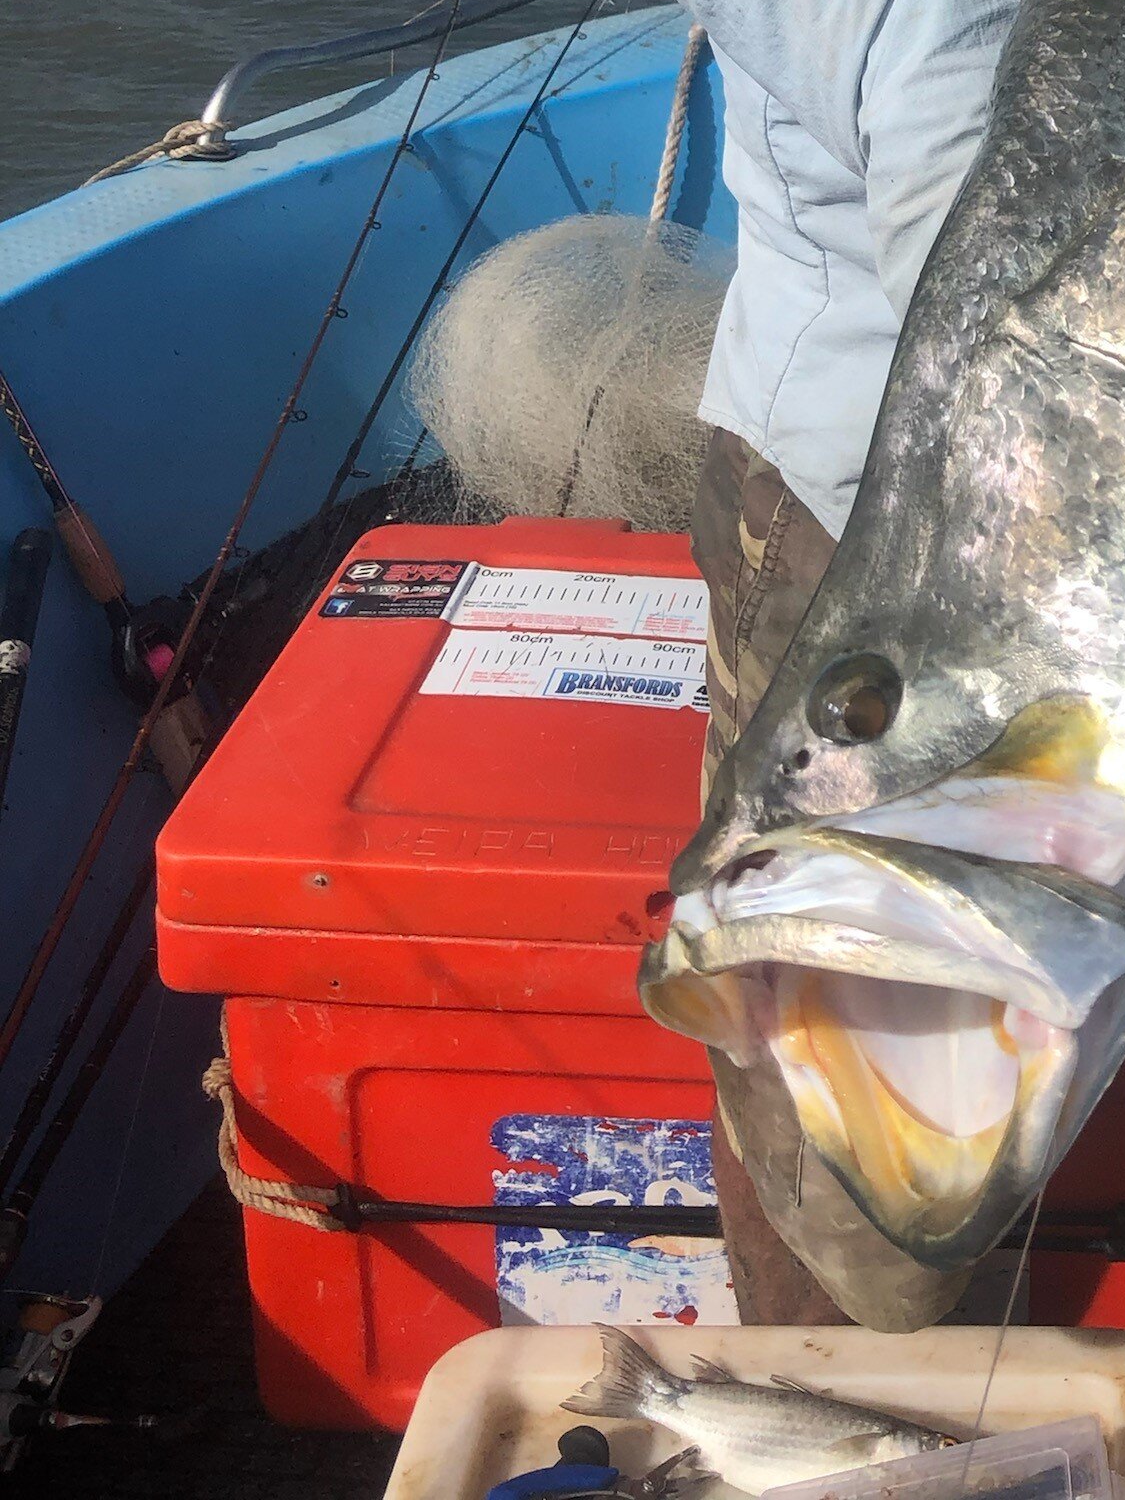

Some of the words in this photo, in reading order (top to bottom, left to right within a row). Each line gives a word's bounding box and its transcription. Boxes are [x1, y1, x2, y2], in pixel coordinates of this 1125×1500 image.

[481, 568, 514, 578] 0cm
[573, 574, 617, 584] 20cm
[380, 584, 451, 594] WRAPPING
[510, 634, 554, 644] 80cm
[652, 643, 696, 655] 90cm
[555, 671, 684, 698] BRANSFORDS
[576, 690, 617, 698] DISCOUNT
